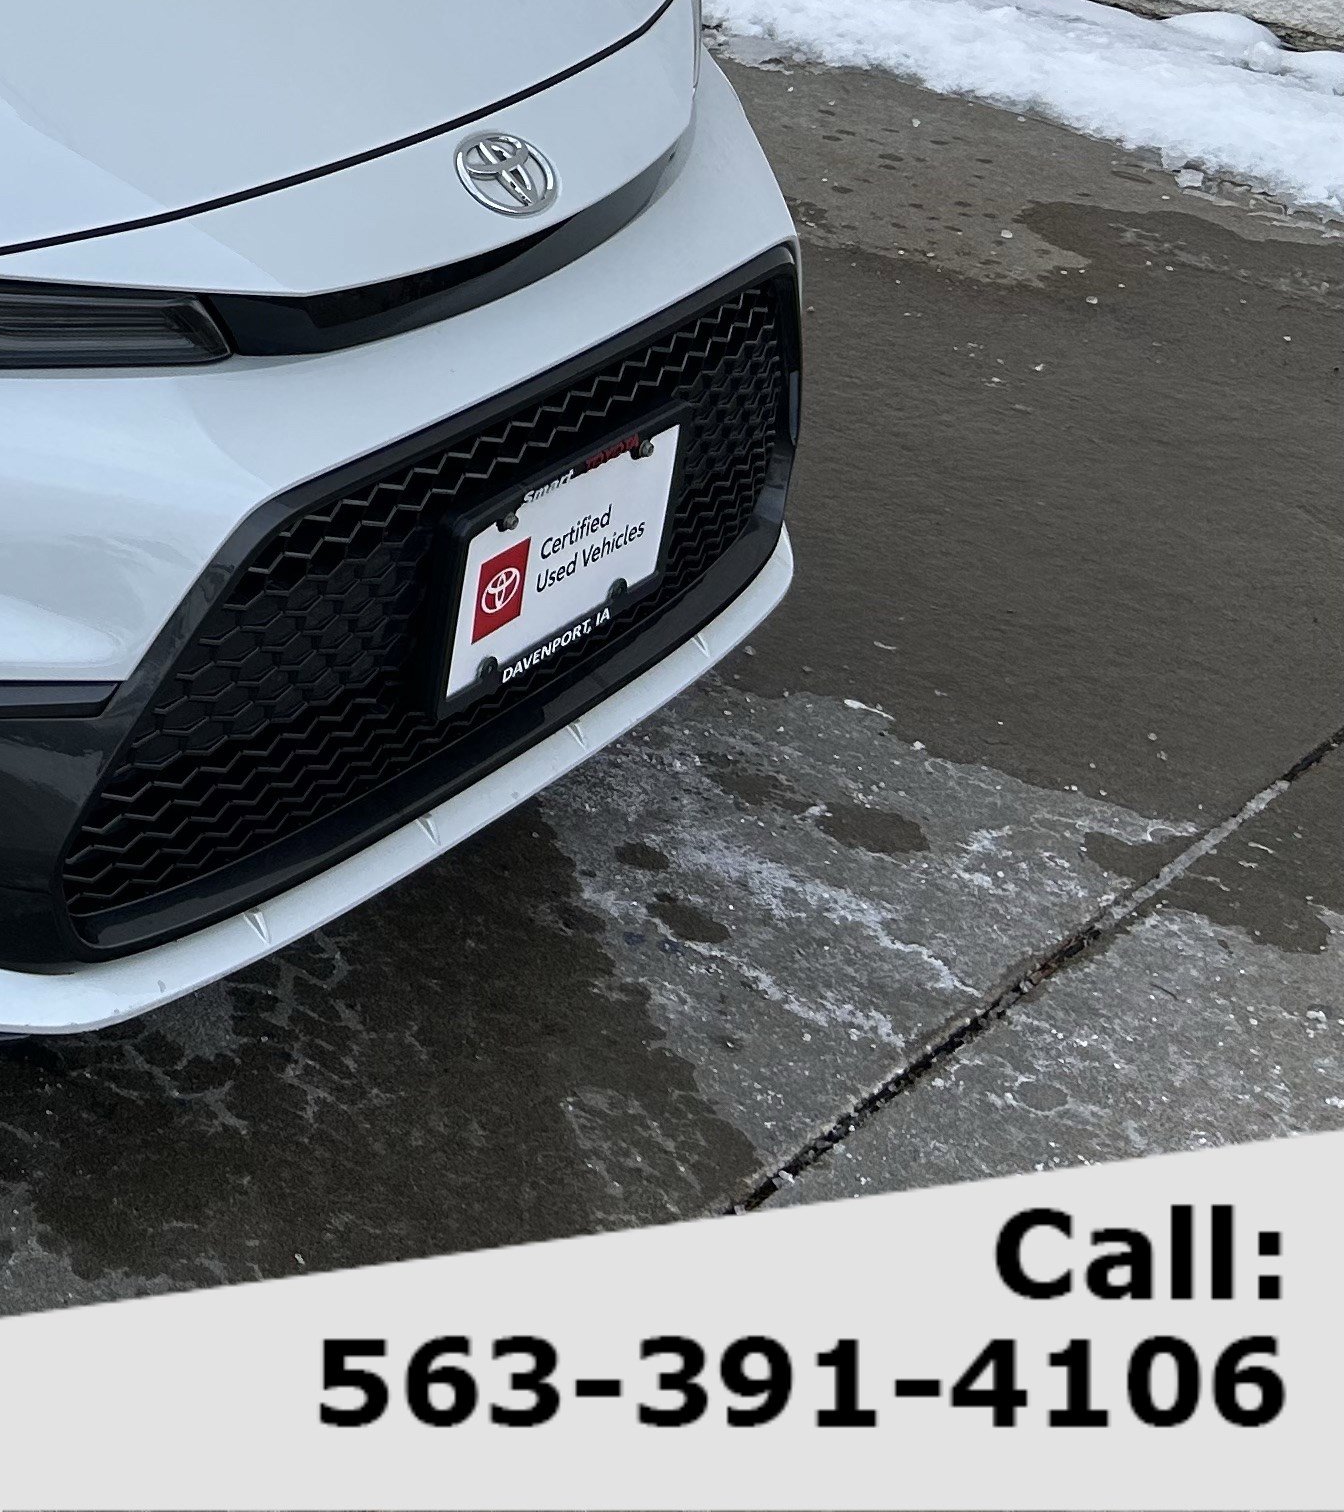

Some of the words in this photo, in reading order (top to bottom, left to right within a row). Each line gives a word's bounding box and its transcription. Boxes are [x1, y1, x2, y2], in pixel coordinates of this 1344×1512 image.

[535, 558, 577, 593] Used
[581, 520, 646, 568] Vehicles
[540, 503, 613, 560] Certified
[502, 620, 592, 684] DAVENPORT,
[595, 607, 611, 629] IA
